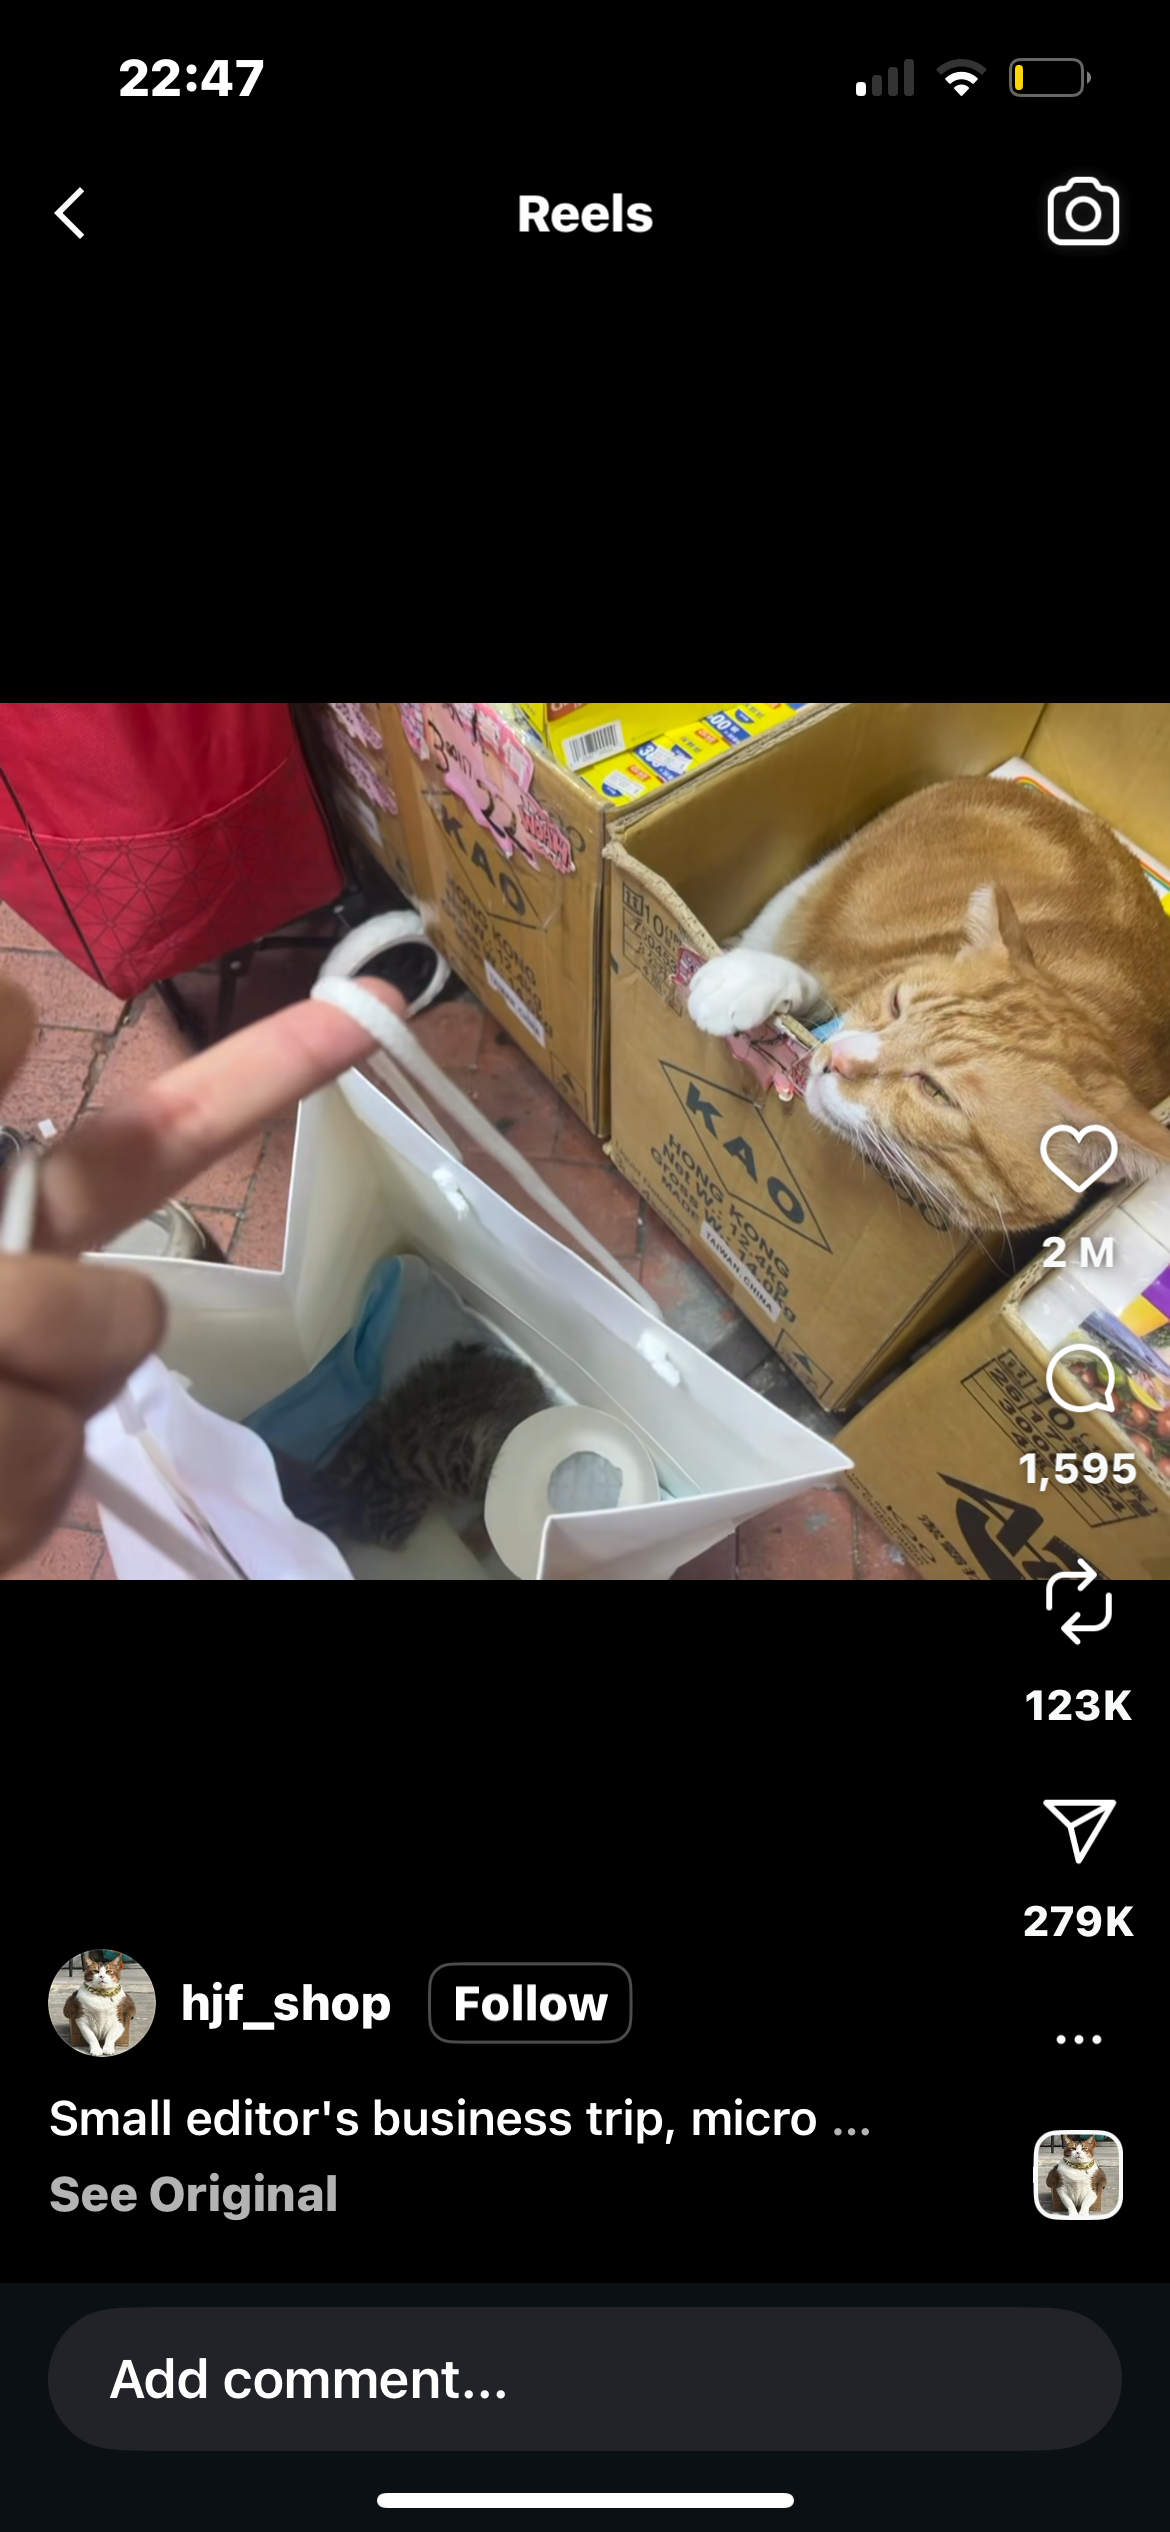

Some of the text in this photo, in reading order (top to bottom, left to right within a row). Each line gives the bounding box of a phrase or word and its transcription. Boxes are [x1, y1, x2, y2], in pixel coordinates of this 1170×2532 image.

[441, 804, 526, 917] KAO
[650, 1147, 699, 1210] Gross
[660, 1175, 700, 1222] MADE
[669, 1134, 790, 1279] HONG KONG
[686, 1081, 806, 1225] KAO
[662, 1144, 690, 1187] Net
[729, 1222, 790, 1298] 12.4kg
[989, 1367, 1024, 1403] 26
